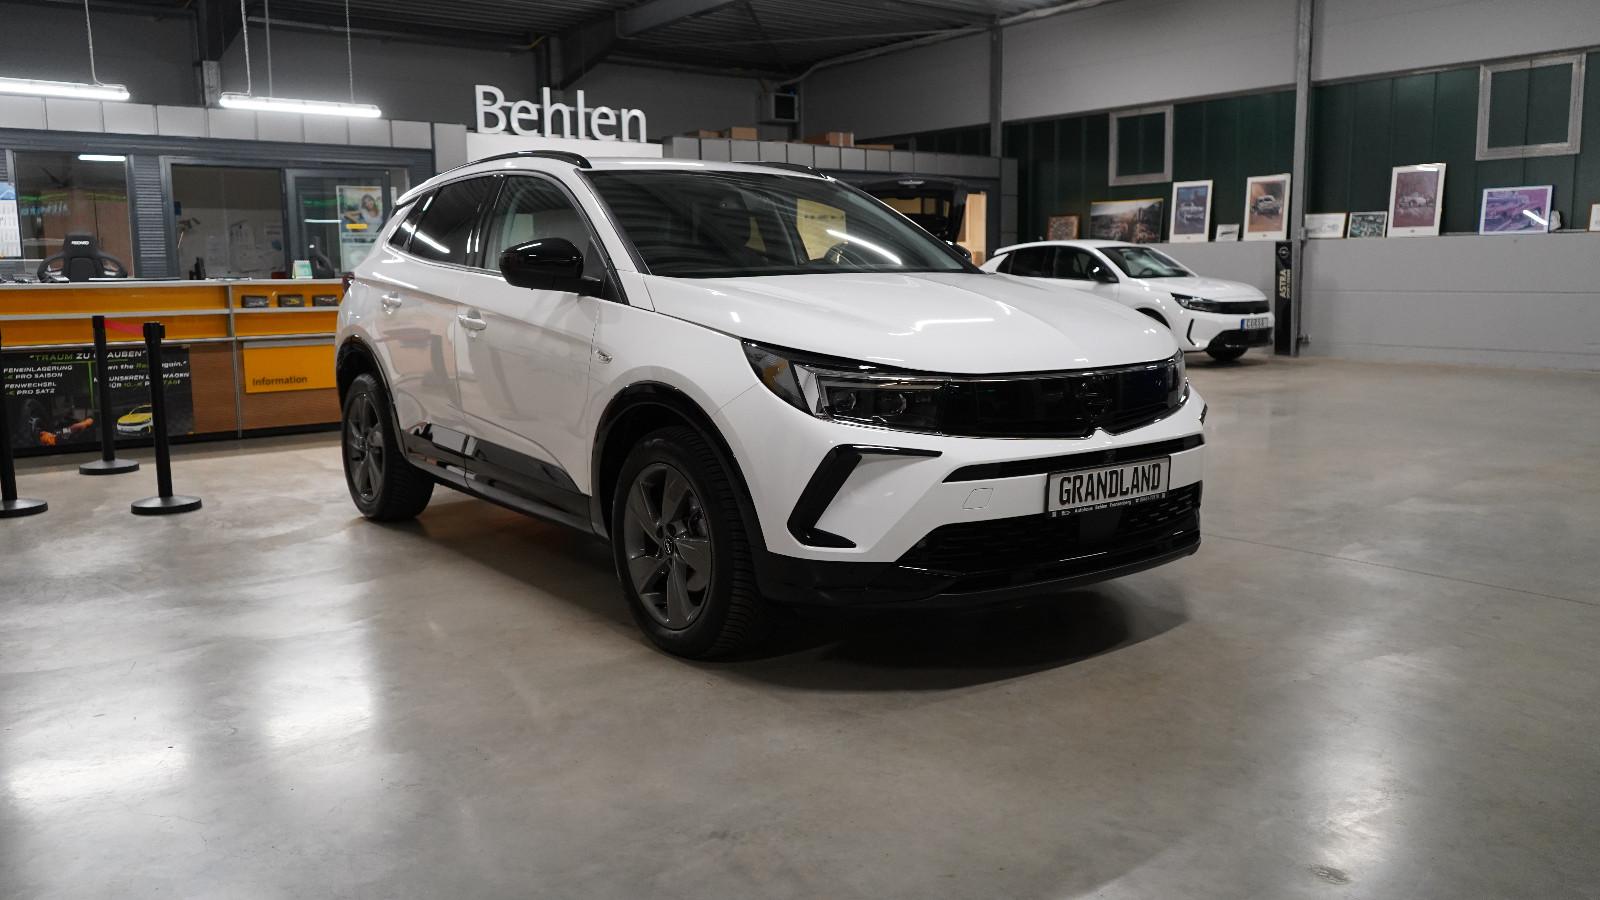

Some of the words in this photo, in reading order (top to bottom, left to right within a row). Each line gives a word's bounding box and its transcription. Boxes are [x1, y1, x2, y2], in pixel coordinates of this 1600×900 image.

[475, 84, 647, 143] Behlen
[1279, 269, 1287, 298] ASTRA
[76, 352, 90, 360] ZU
[3, 365, 73, 374] FENEINLAGERUNG
[4, 381, 57, 389] FENWECHSEL
[252, 376, 308, 386] Information
[1059, 463, 1161, 506] GRANDLAND
